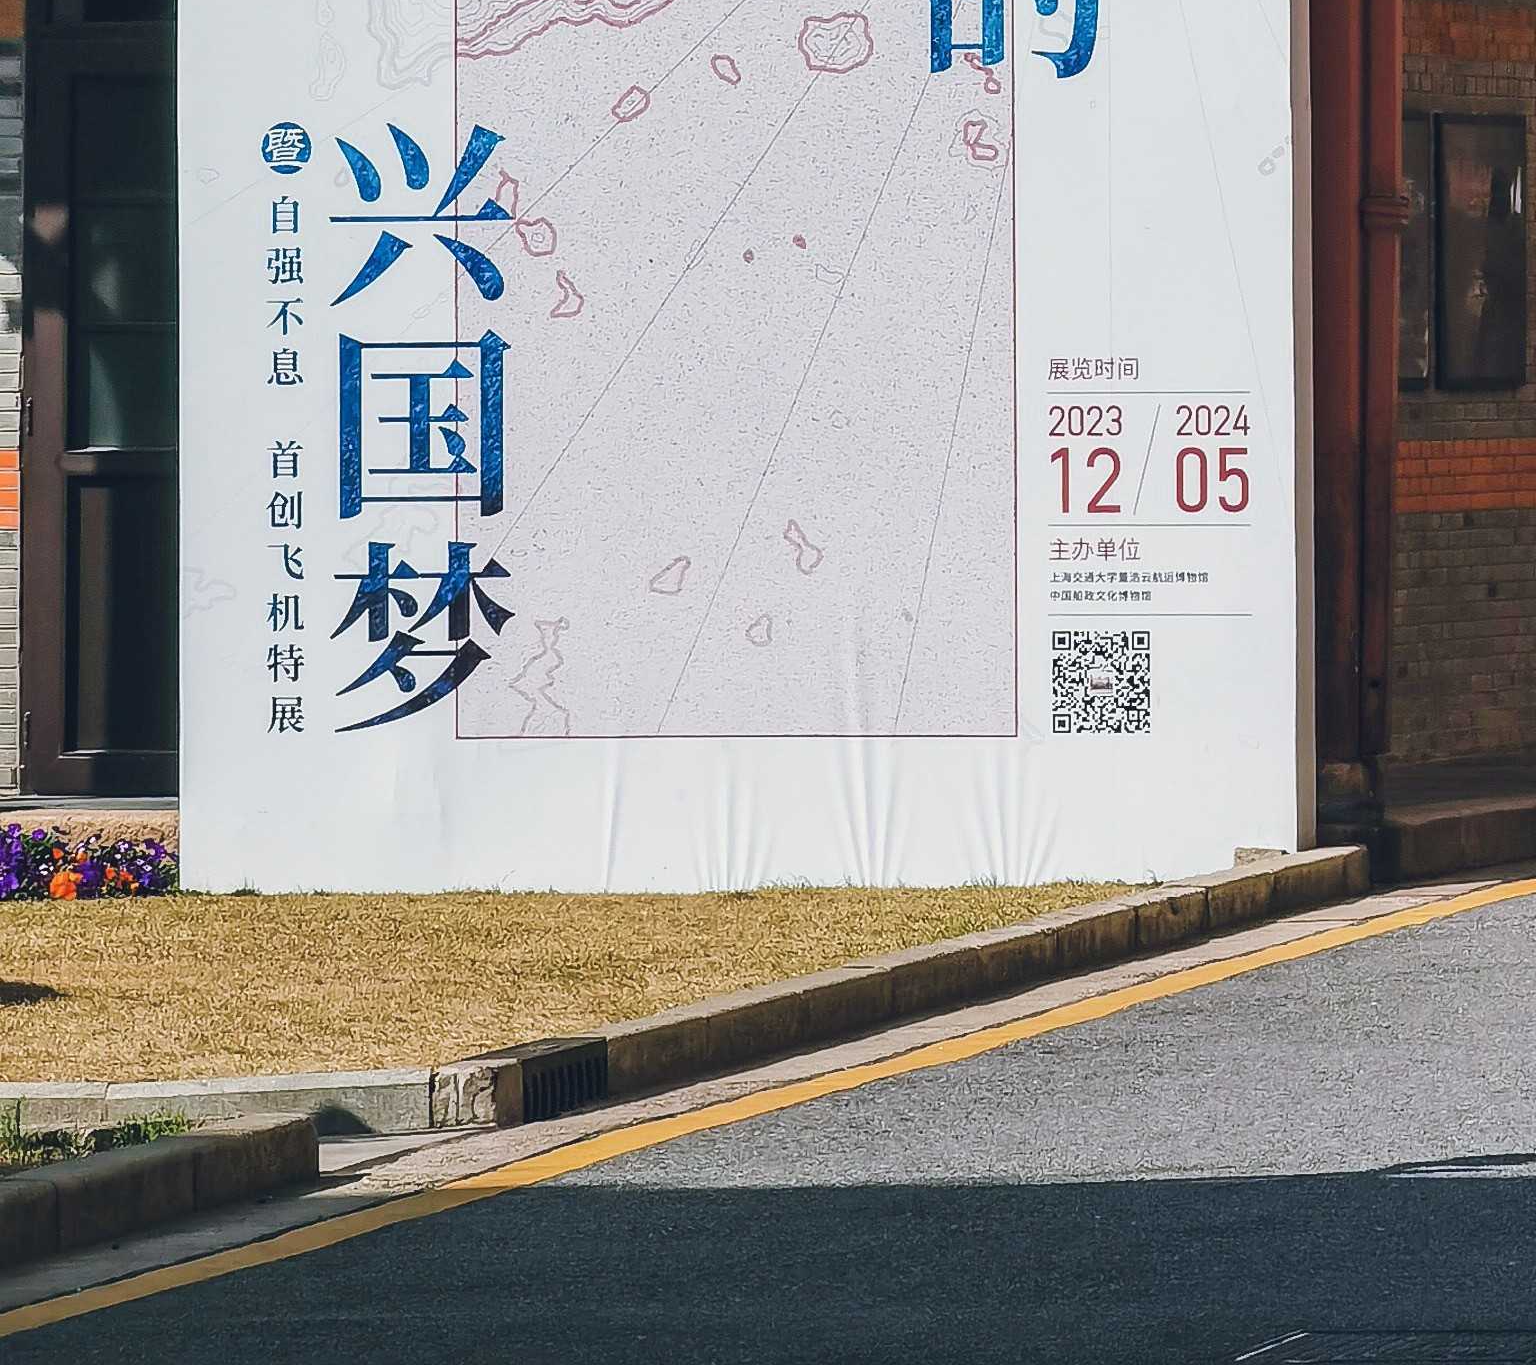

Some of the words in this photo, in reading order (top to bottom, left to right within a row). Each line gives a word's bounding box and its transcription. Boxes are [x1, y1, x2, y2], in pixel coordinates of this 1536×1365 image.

[266, 195, 304, 387] 自强不息
[1047, 356, 1140, 381] 展览时间
[329, 122, 516, 734] 兴国梦
[1048, 404, 1123, 437] 2023
[1175, 404, 1251, 437] 2024
[1049, 446, 1121, 514] 12
[1175, 446, 1250, 514] 05
[1048, 537, 1141, 562] 主办单位
[266, 440, 305, 735] 首创飞机特展
